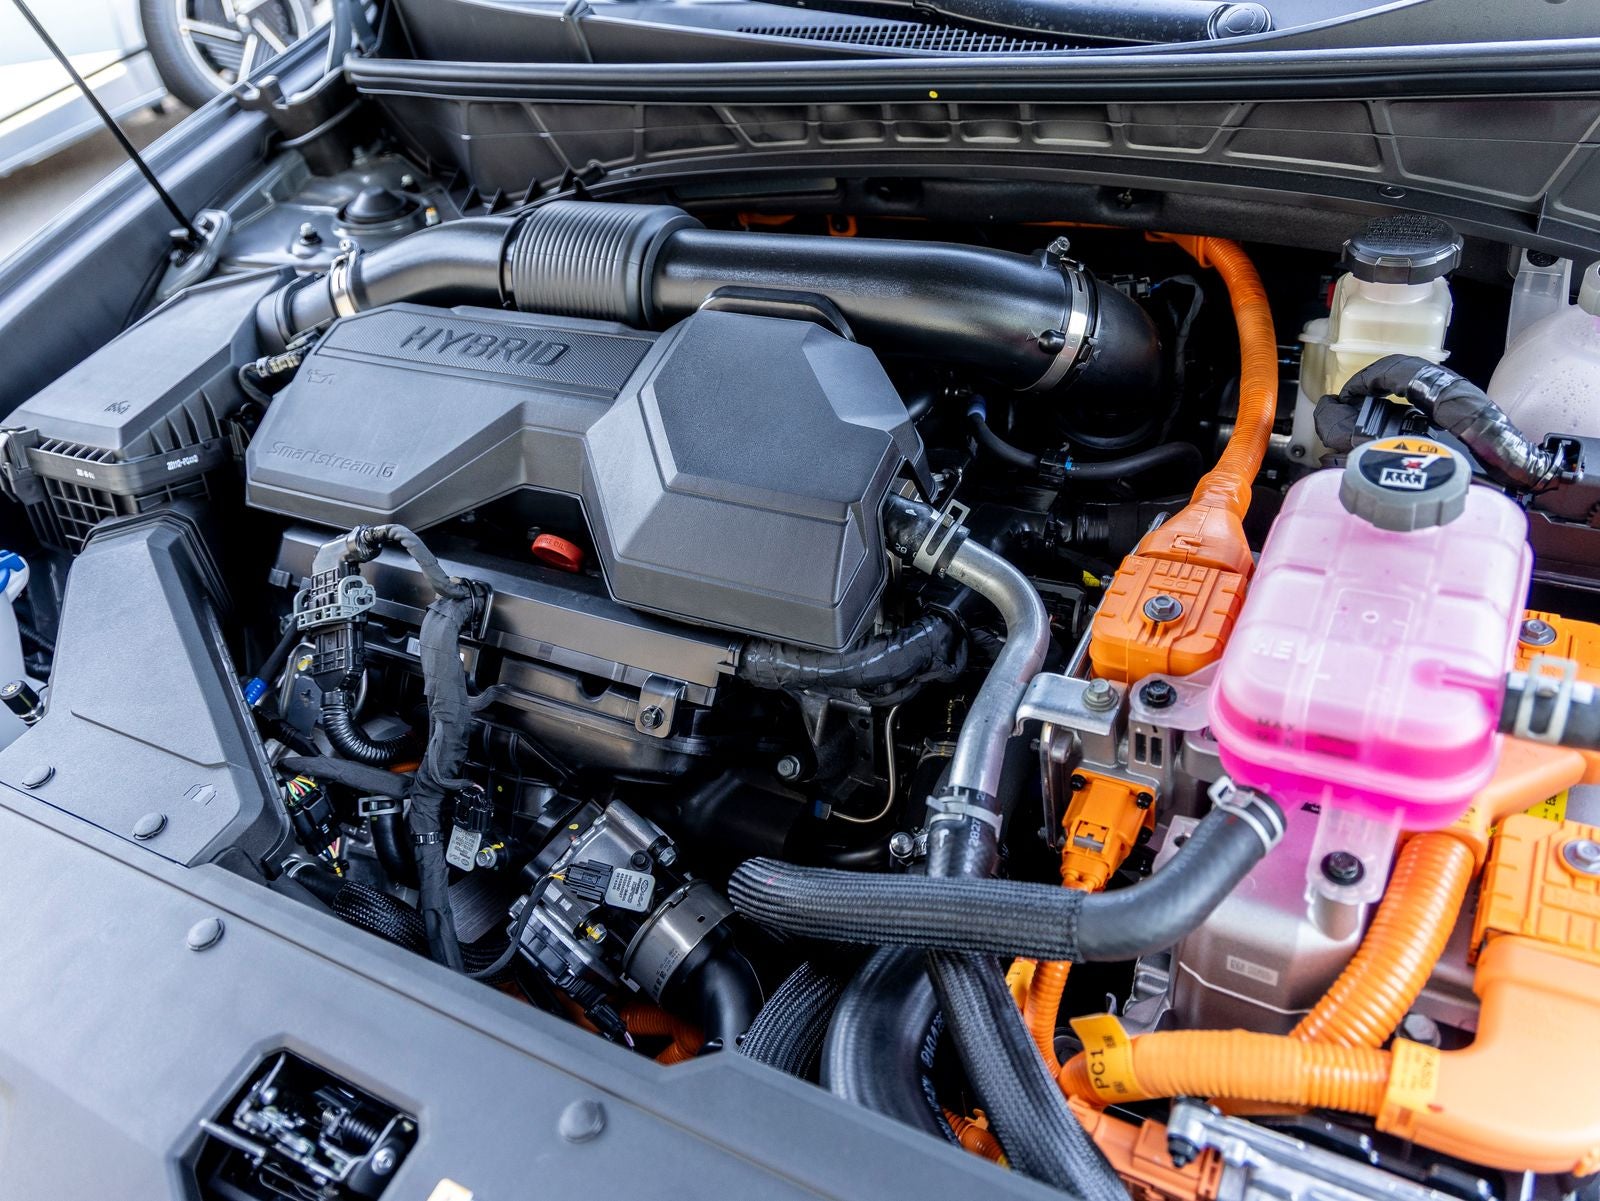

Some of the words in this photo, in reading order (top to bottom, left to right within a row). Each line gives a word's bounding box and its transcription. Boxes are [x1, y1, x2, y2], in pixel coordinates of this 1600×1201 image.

[400, 325, 571, 367] HYBRID
[267, 440, 377, 476] Smartstream
[1090, 1049, 1110, 1090] PC1
